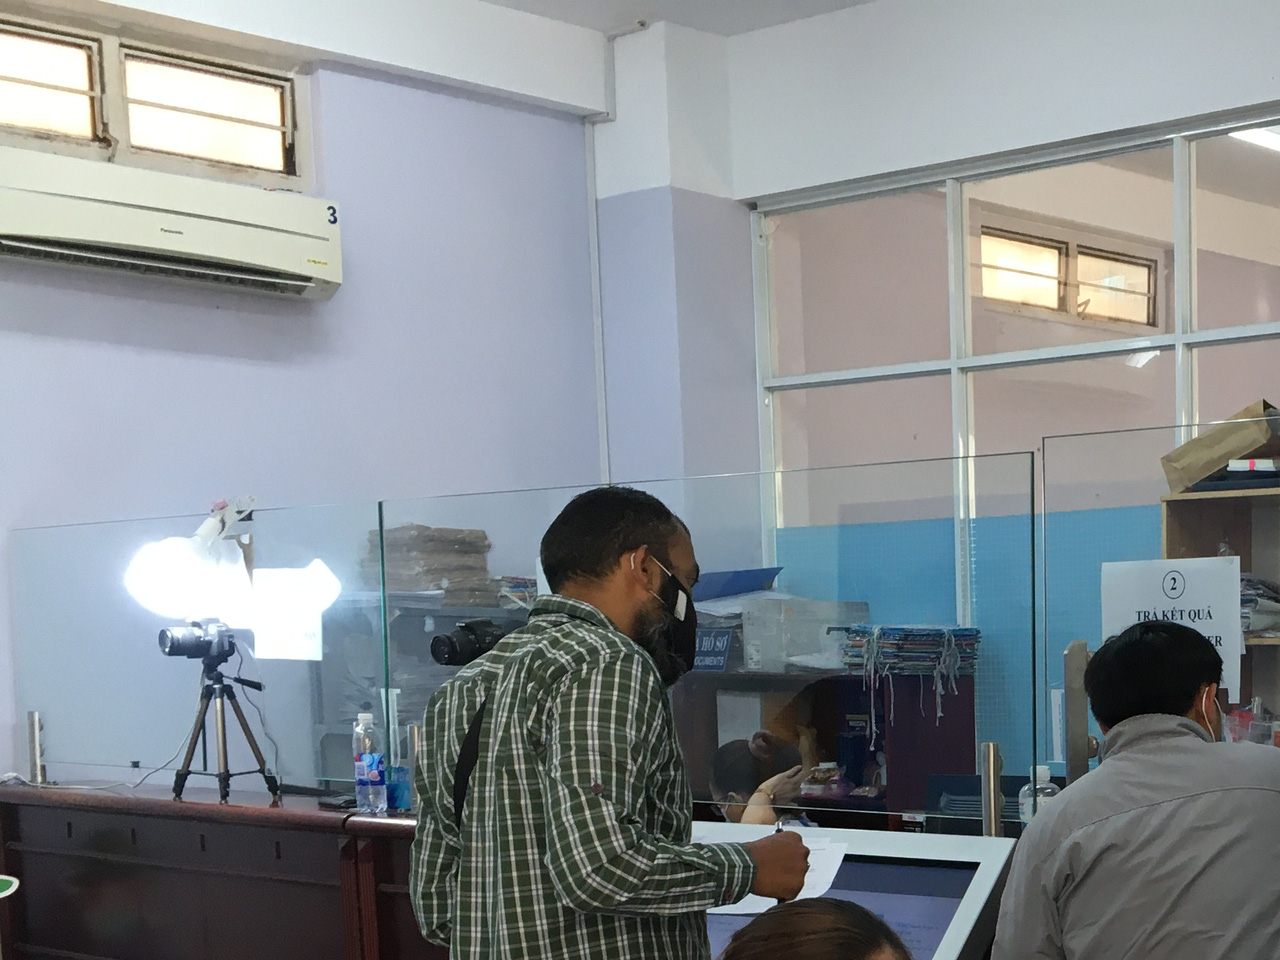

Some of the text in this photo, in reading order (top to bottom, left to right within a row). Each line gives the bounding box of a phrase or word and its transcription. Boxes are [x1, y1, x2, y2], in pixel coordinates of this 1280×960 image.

[327, 206, 337, 224] 3
[1170, 577, 1177, 591] 2
[1136, 606, 1213, 622] TRẢ KẾT QUẢ
[694, 656, 724, 666] OCUMENTS
